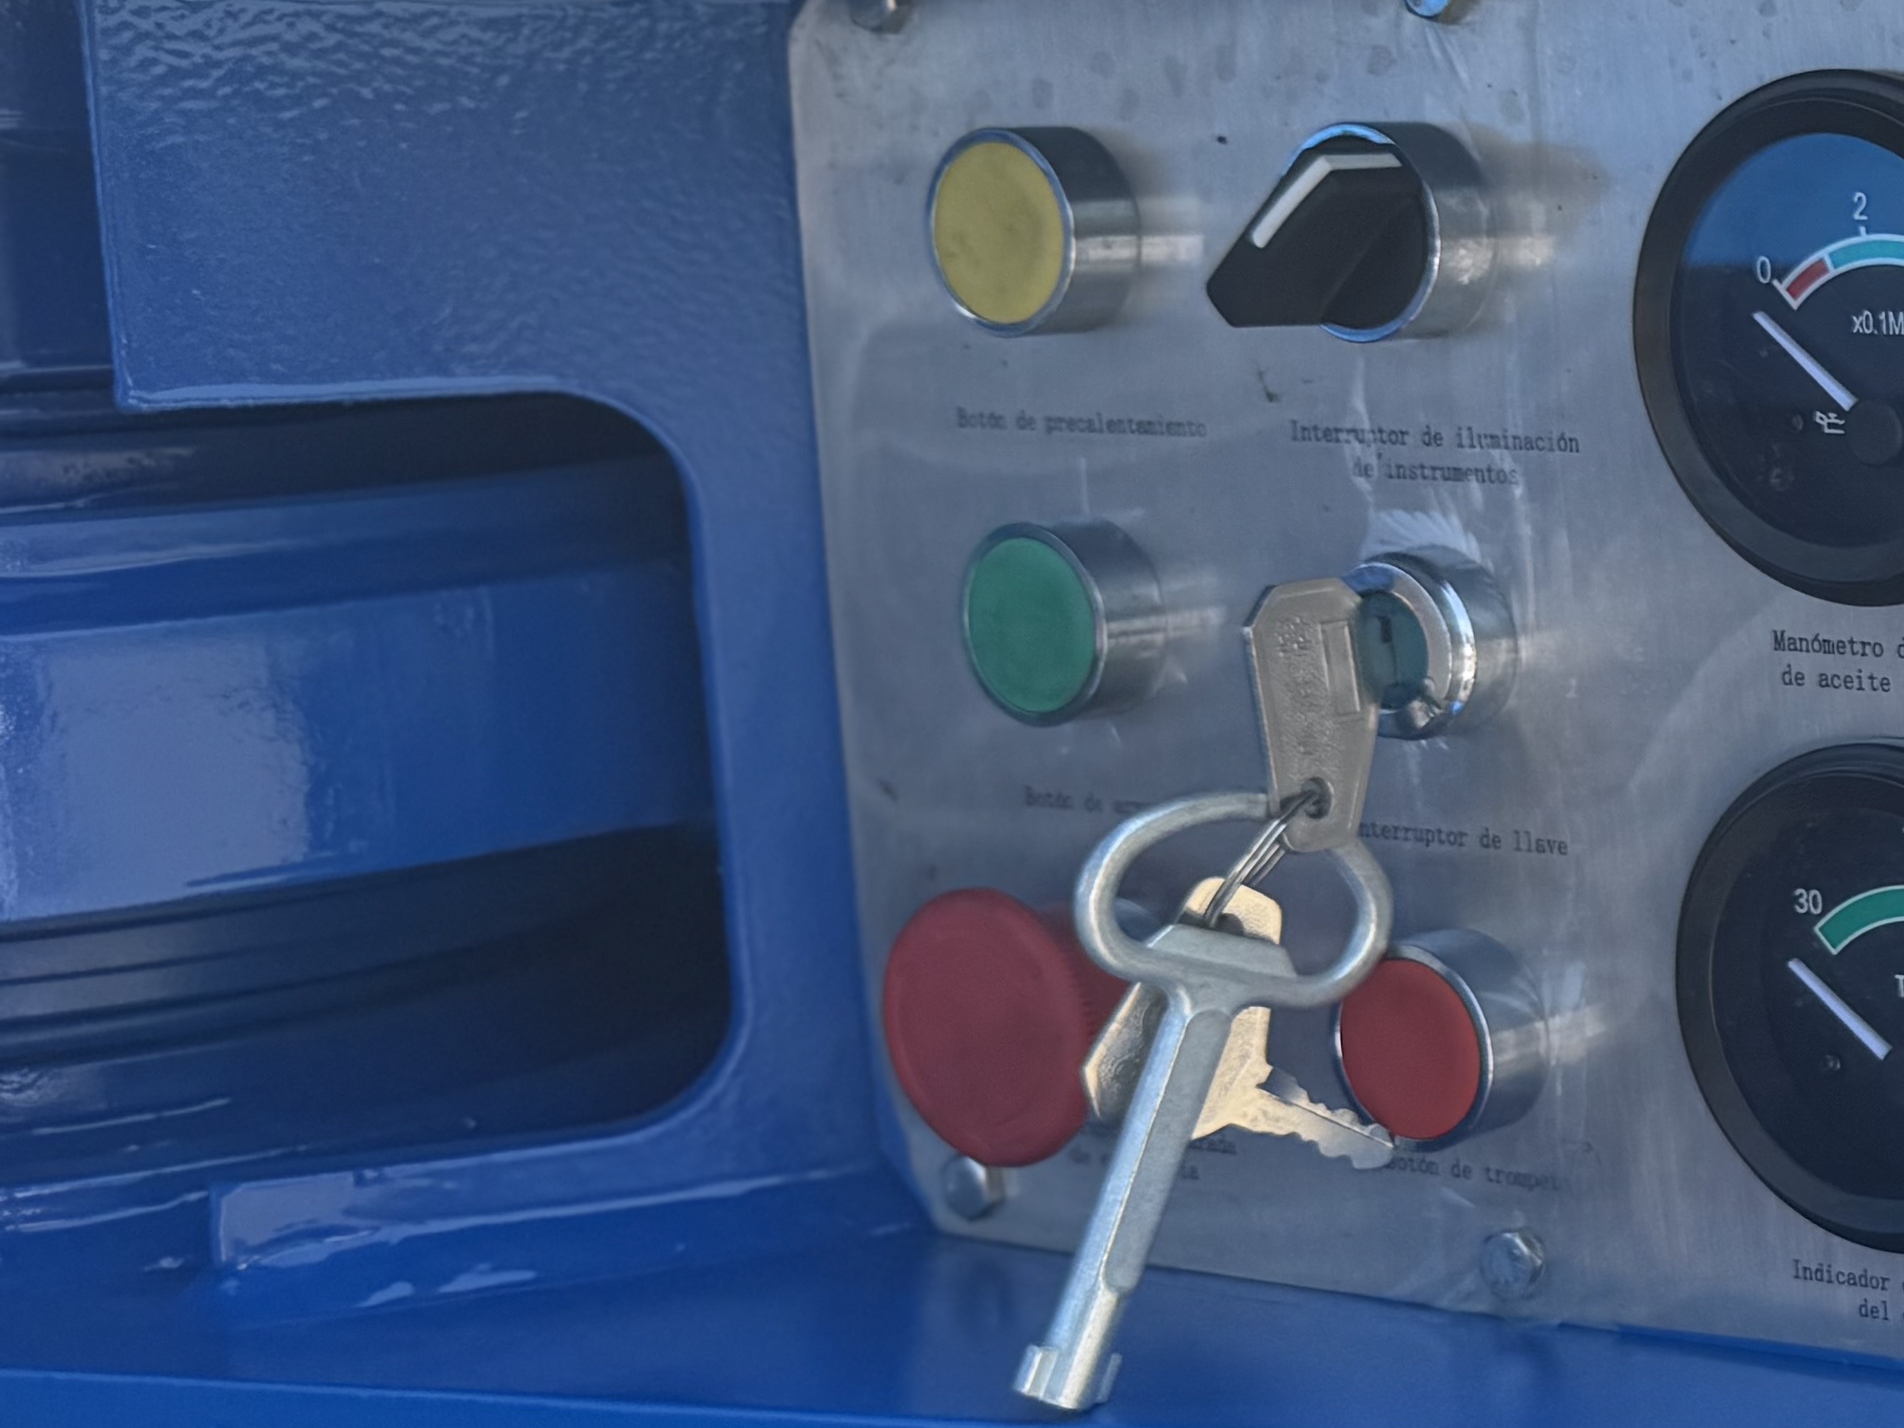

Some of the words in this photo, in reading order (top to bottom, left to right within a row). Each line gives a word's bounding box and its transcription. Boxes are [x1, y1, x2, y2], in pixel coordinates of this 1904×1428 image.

[1757, 256, 1771, 283] 0
[1853, 192, 1868, 220] 2
[1422, 424, 1443, 448] de
[1772, 630, 1884, 658] Manómetro
[1782, 665, 1805, 686] de
[1818, 669, 1891, 692] aceite
[1359, 821, 1468, 848] nterruptor
[1479, 827, 1501, 850] de
[1513, 829, 1569, 856] llave
[1794, 888, 1823, 914] 30
[1452, 1158, 1473, 1181] de
[1792, 1259, 1890, 1291] Indicador
[1859, 1299, 1890, 1320] del
